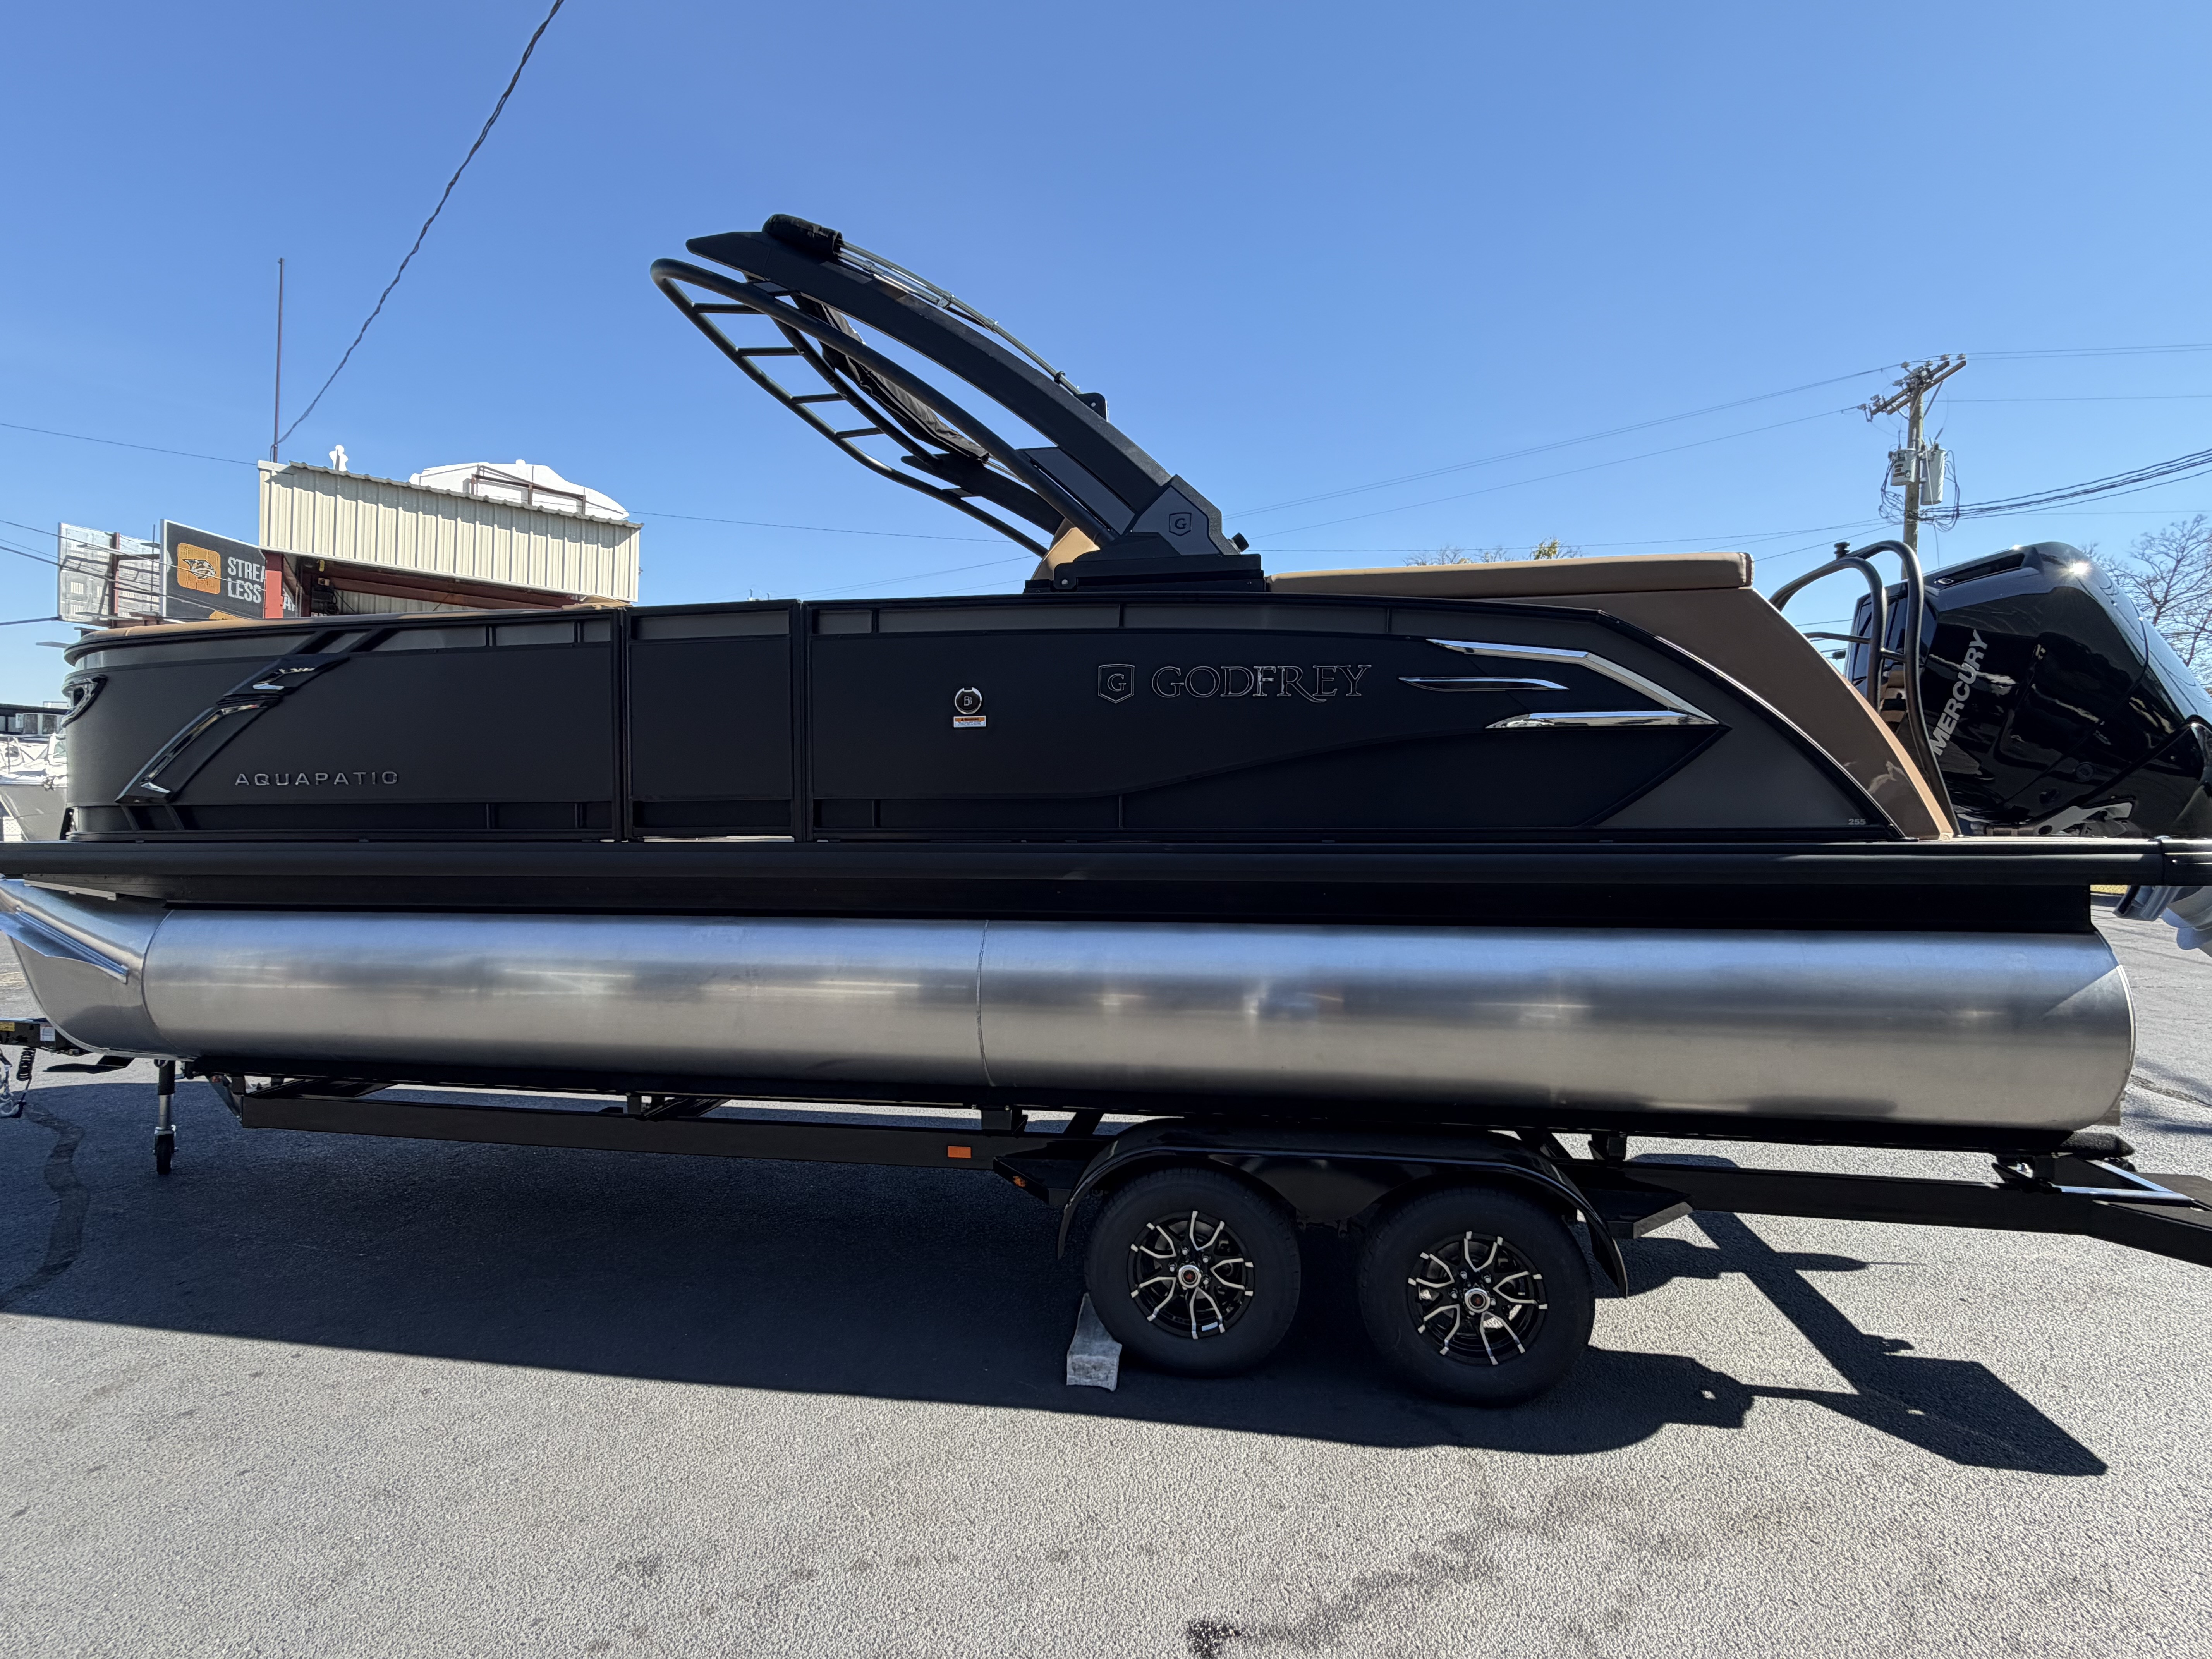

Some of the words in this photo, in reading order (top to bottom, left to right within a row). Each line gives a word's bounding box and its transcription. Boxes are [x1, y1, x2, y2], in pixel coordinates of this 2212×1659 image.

[1175, 518, 1187, 529] G
[227, 577, 261, 603] LESS
[1107, 673, 1127, 692] G
[1152, 665, 1372, 703] GODFREY
[1929, 629, 1988, 756] MERCURY
[235, 771, 397, 786] AQUAPATIO
